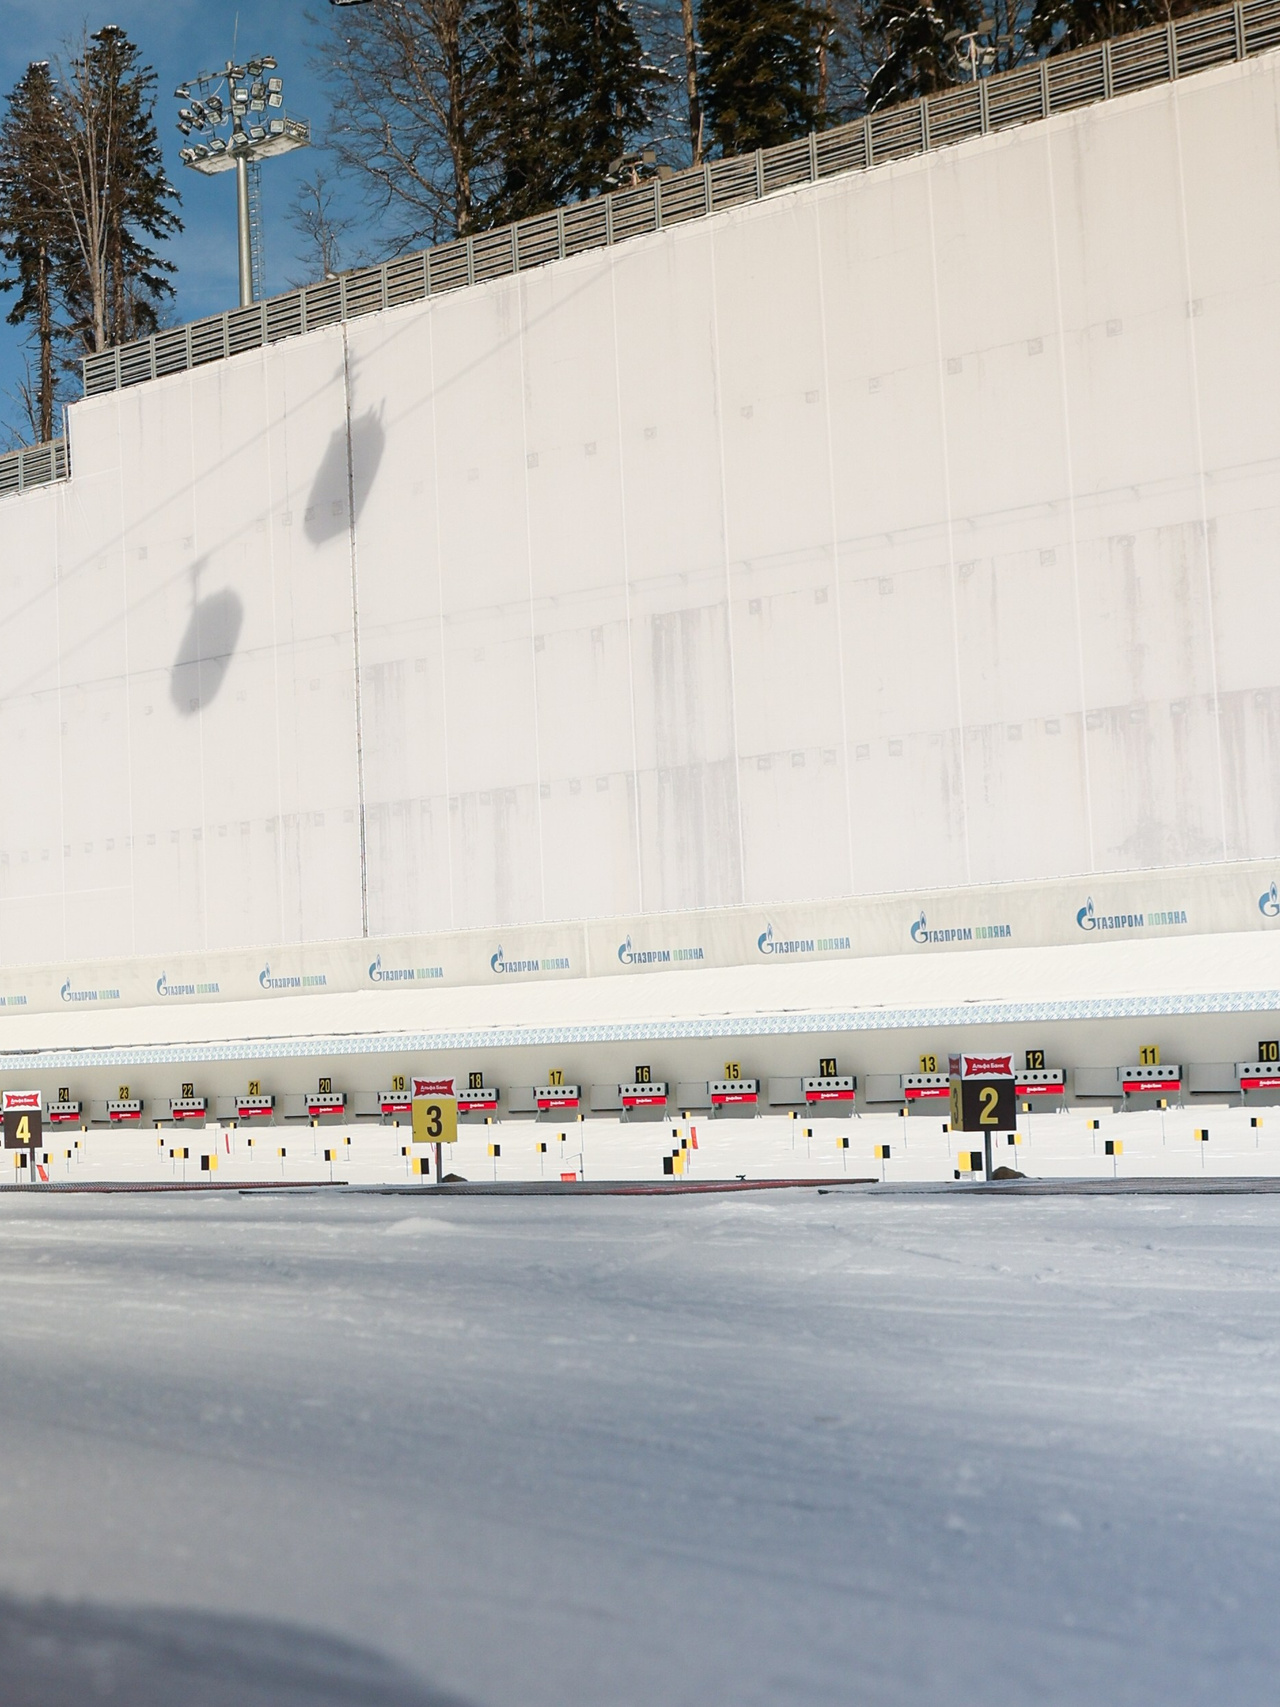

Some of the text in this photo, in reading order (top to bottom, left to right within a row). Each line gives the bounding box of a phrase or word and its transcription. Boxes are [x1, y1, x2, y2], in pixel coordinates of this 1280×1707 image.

[1096, 910, 1188, 930] ГАЗПРОМ ПОЛЯНА
[929, 925, 1011, 943] ГАЗПРОМ ПОЛЯНА
[774, 937, 851, 954] ГАЗПРОМ ПОЛЯНА
[633, 947, 704, 964] ГАЗПРОМ ПОЛЯНА
[505, 957, 570, 973] ГАЗПРОМ ПОЛЯНА
[382, 969, 415, 982] ГАЗПРОМ
[1027, 1052, 1043, 1068] 12
[1141, 1048, 1156, 1064] 11
[1260, 1043, 1278, 1061] 10
[725, 1064, 739, 1079] 15
[821, 1060, 836, 1076] 14
[921, 1056, 936, 1072] 13
[972, 1062, 991, 1071] Альфа
[470, 1074, 481, 1088] 18
[550, 1071, 562, 1085] 17
[636, 1067, 649, 1082] 16
[183, 1084, 193, 1097] 22
[249, 1082, 259, 1094] 21
[320, 1079, 331, 1093] 20
[393, 1077, 404, 1090] 19
[59, 1088, 69, 1101] 24
[120, 1087, 129, 1099] 23
[979, 1086, 999, 1125] 2
[426, 1105, 443, 1137] 3
[15, 1115, 31, 1144] 4
